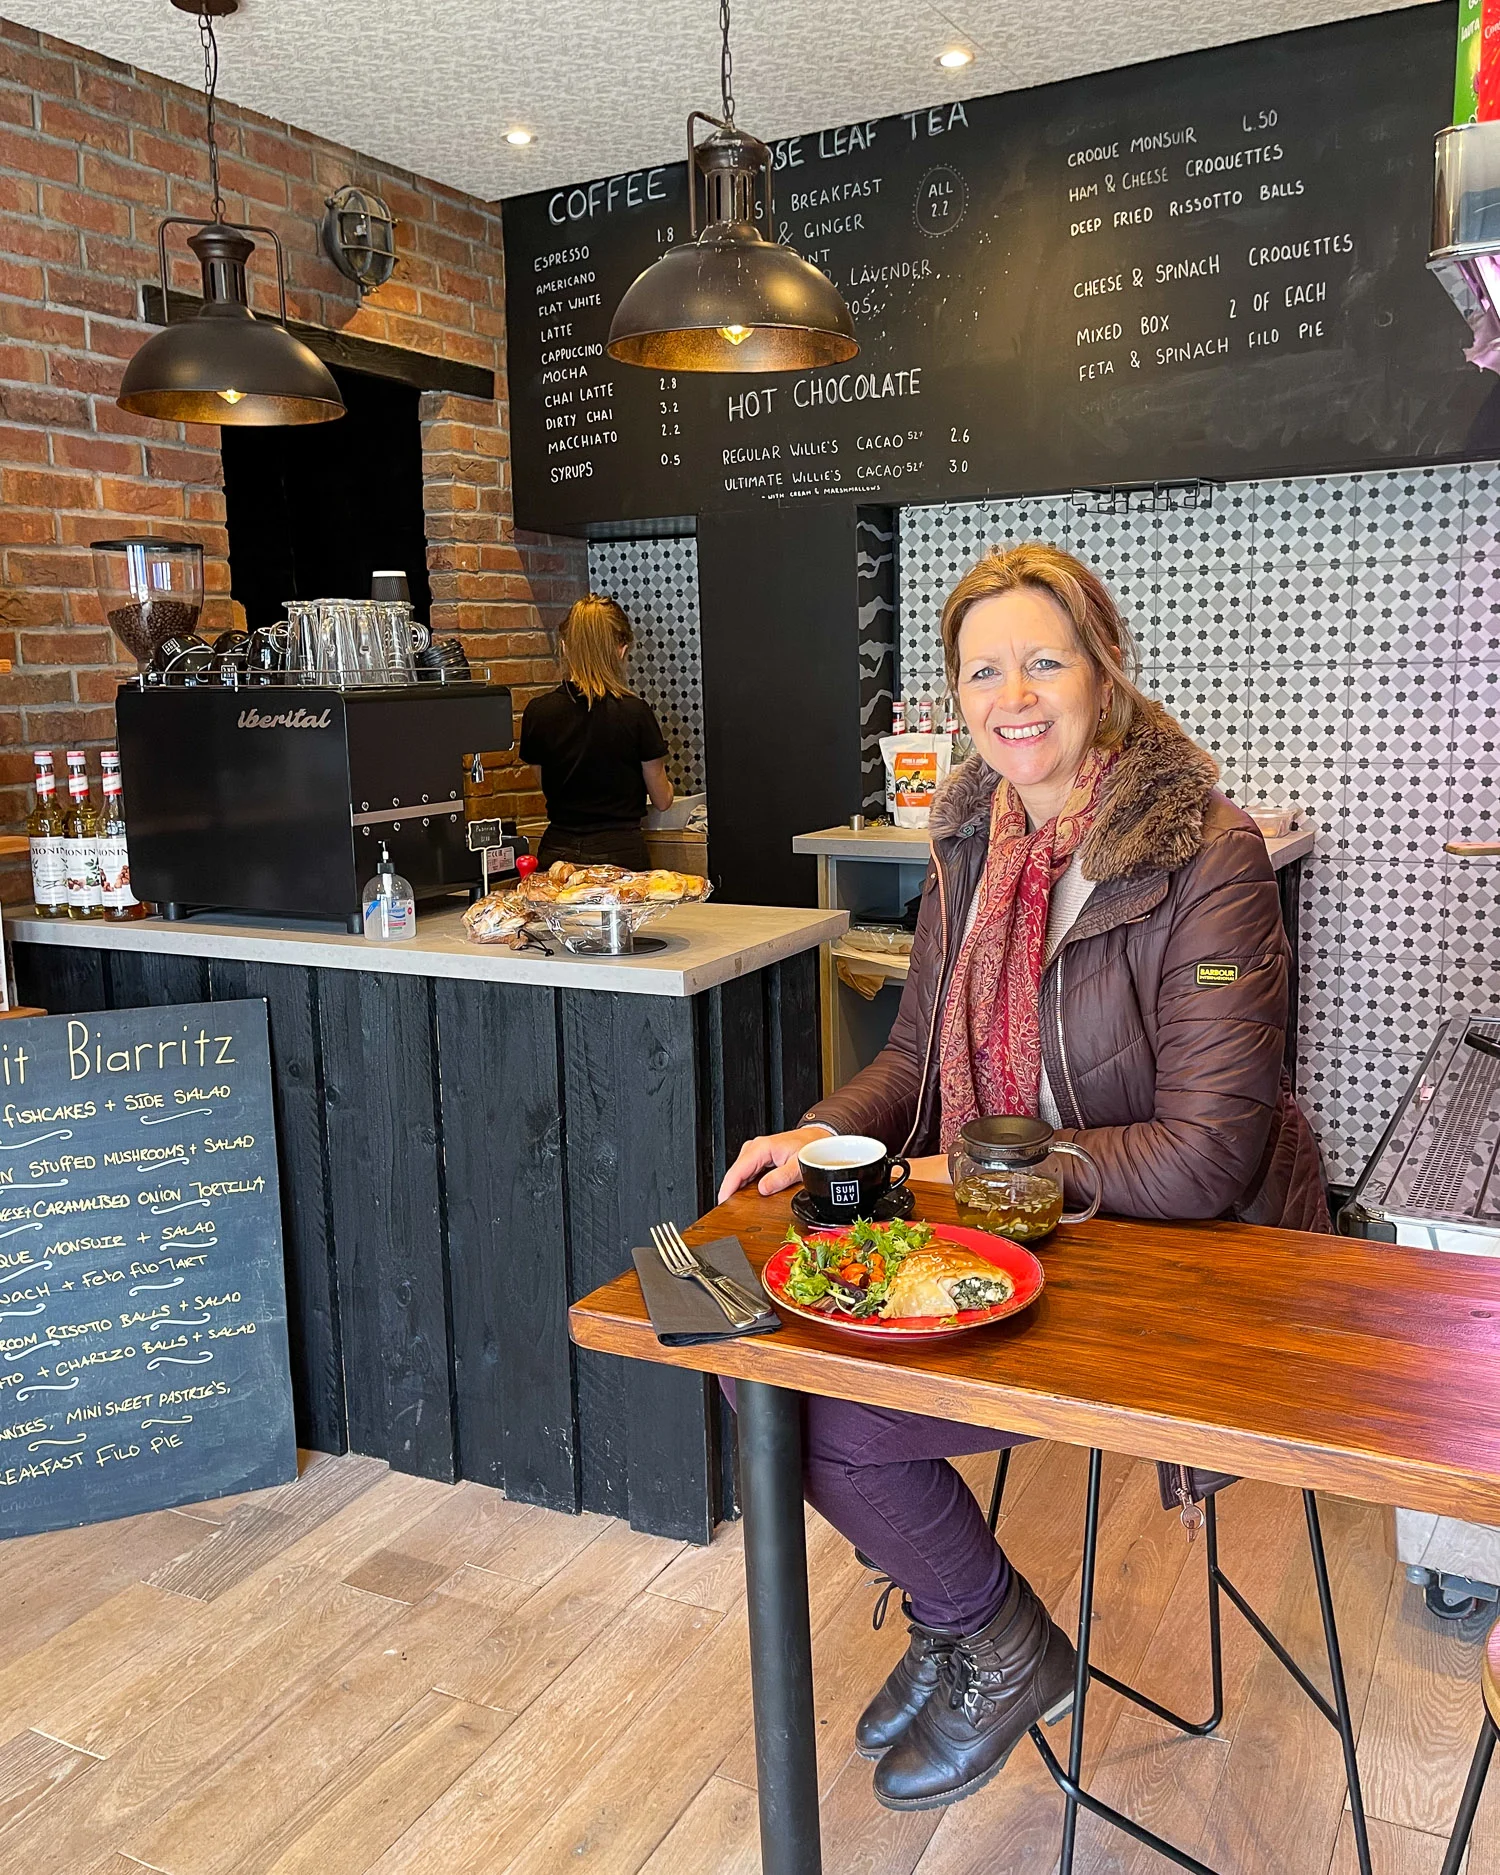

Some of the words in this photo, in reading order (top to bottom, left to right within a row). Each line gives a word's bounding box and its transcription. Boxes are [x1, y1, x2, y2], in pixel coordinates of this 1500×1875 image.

[818, 119, 880, 159] LEAF
[903, 101, 970, 141] TEA
[1067, 142, 1120, 168] CROQUE
[1130, 126, 1198, 154] MONSUIR
[1068, 183, 1099, 203] HAM
[1104, 173, 1116, 193] &
[1121, 166, 1170, 191] CHEESE
[1185, 143, 1284, 177] CROQUETTES
[548, 168, 667, 226] COFFEE
[790, 178, 883, 213] BREAKFAST
[928, 181, 954, 198] ALL
[1070, 217, 1103, 237] DEEP
[1113, 207, 1154, 229] FRIED
[1169, 190, 1243, 217] RISSOTTO
[1259, 179, 1305, 201] BALLS
[777, 221, 795, 246] &
[804, 213, 866, 240] GINGER
[534, 245, 591, 273] ESPRESSO
[656, 226, 675, 243] 1.8
[850, 259, 933, 287] LAVENDER
[1073, 273, 1124, 299] CHEESE
[1131, 267, 1144, 288] &
[1155, 254, 1221, 283] SPINACH
[1248, 233, 1354, 267] CROQUETTES
[535, 271, 597, 296] AMERICANO
[538, 301, 564, 318] FLAT
[568, 293, 602, 311] WHITE
[1076, 322, 1123, 347] MIXED
[1140, 314, 1171, 336] BOX
[1228, 298, 1238, 320] 2
[1252, 291, 1271, 312] OF
[1284, 281, 1327, 308] EACH
[540, 323, 574, 343] LATTE
[541, 343, 604, 366] CAPPUCCINO
[1078, 360, 1115, 383] FETA
[1130, 350, 1142, 369] &
[1155, 336, 1230, 366] SPINACH
[1248, 328, 1280, 349] FILO
[1298, 320, 1325, 339] PIE
[542, 365, 589, 385] MOCHA
[544, 391, 574, 409] CHAI
[579, 382, 615, 402] LATTE
[659, 377, 678, 391] 2.8
[728, 387, 778, 423] HOT
[793, 367, 923, 409] CHOCOLATE
[545, 413, 577, 431] DIRTY
[586, 408, 614, 424] CHAI
[659, 402, 680, 415] 3.2
[548, 430, 619, 455] MACCHIATO
[661, 423, 682, 437] 2.2
[722, 444, 782, 466] REGULAR
[856, 433, 904, 451] CACAO
[949, 426, 971, 444] 2.6
[550, 461, 594, 484] SYRUPS
[660, 453, 682, 466] 0.5
[724, 471, 784, 492] ULTIMATE
[856, 463, 902, 480] CACAO
[1200, 968, 1235, 977] BARBOUR
[67, 1020, 237, 1081] Biarritz
[124, 1093, 165, 1112] SIDE
[174, 1085, 231, 1105] SALAD
[104, 1144, 184, 1166] MUSHROOMS
[204, 1135, 255, 1153] SALAD
[33, 1194, 131, 1219] CARAMALISED
[189, 1176, 265, 1199] TORTILLA
[835, 1184, 856, 1194] SUN
[836, 1193, 856, 1203] DAY
[43, 1234, 126, 1259] MONSUIR
[161, 1220, 215, 1241] SALAD
[45, 1318, 113, 1341] RISOTTO
[120, 1305, 171, 1328] BALLS
[194, 1291, 241, 1311] SALAD
[55, 1346, 137, 1377] CHARIZO
[142, 1336, 188, 1354] BALLS
[208, 1322, 257, 1340] SALAD
[105, 1393, 153, 1416] SWEET
